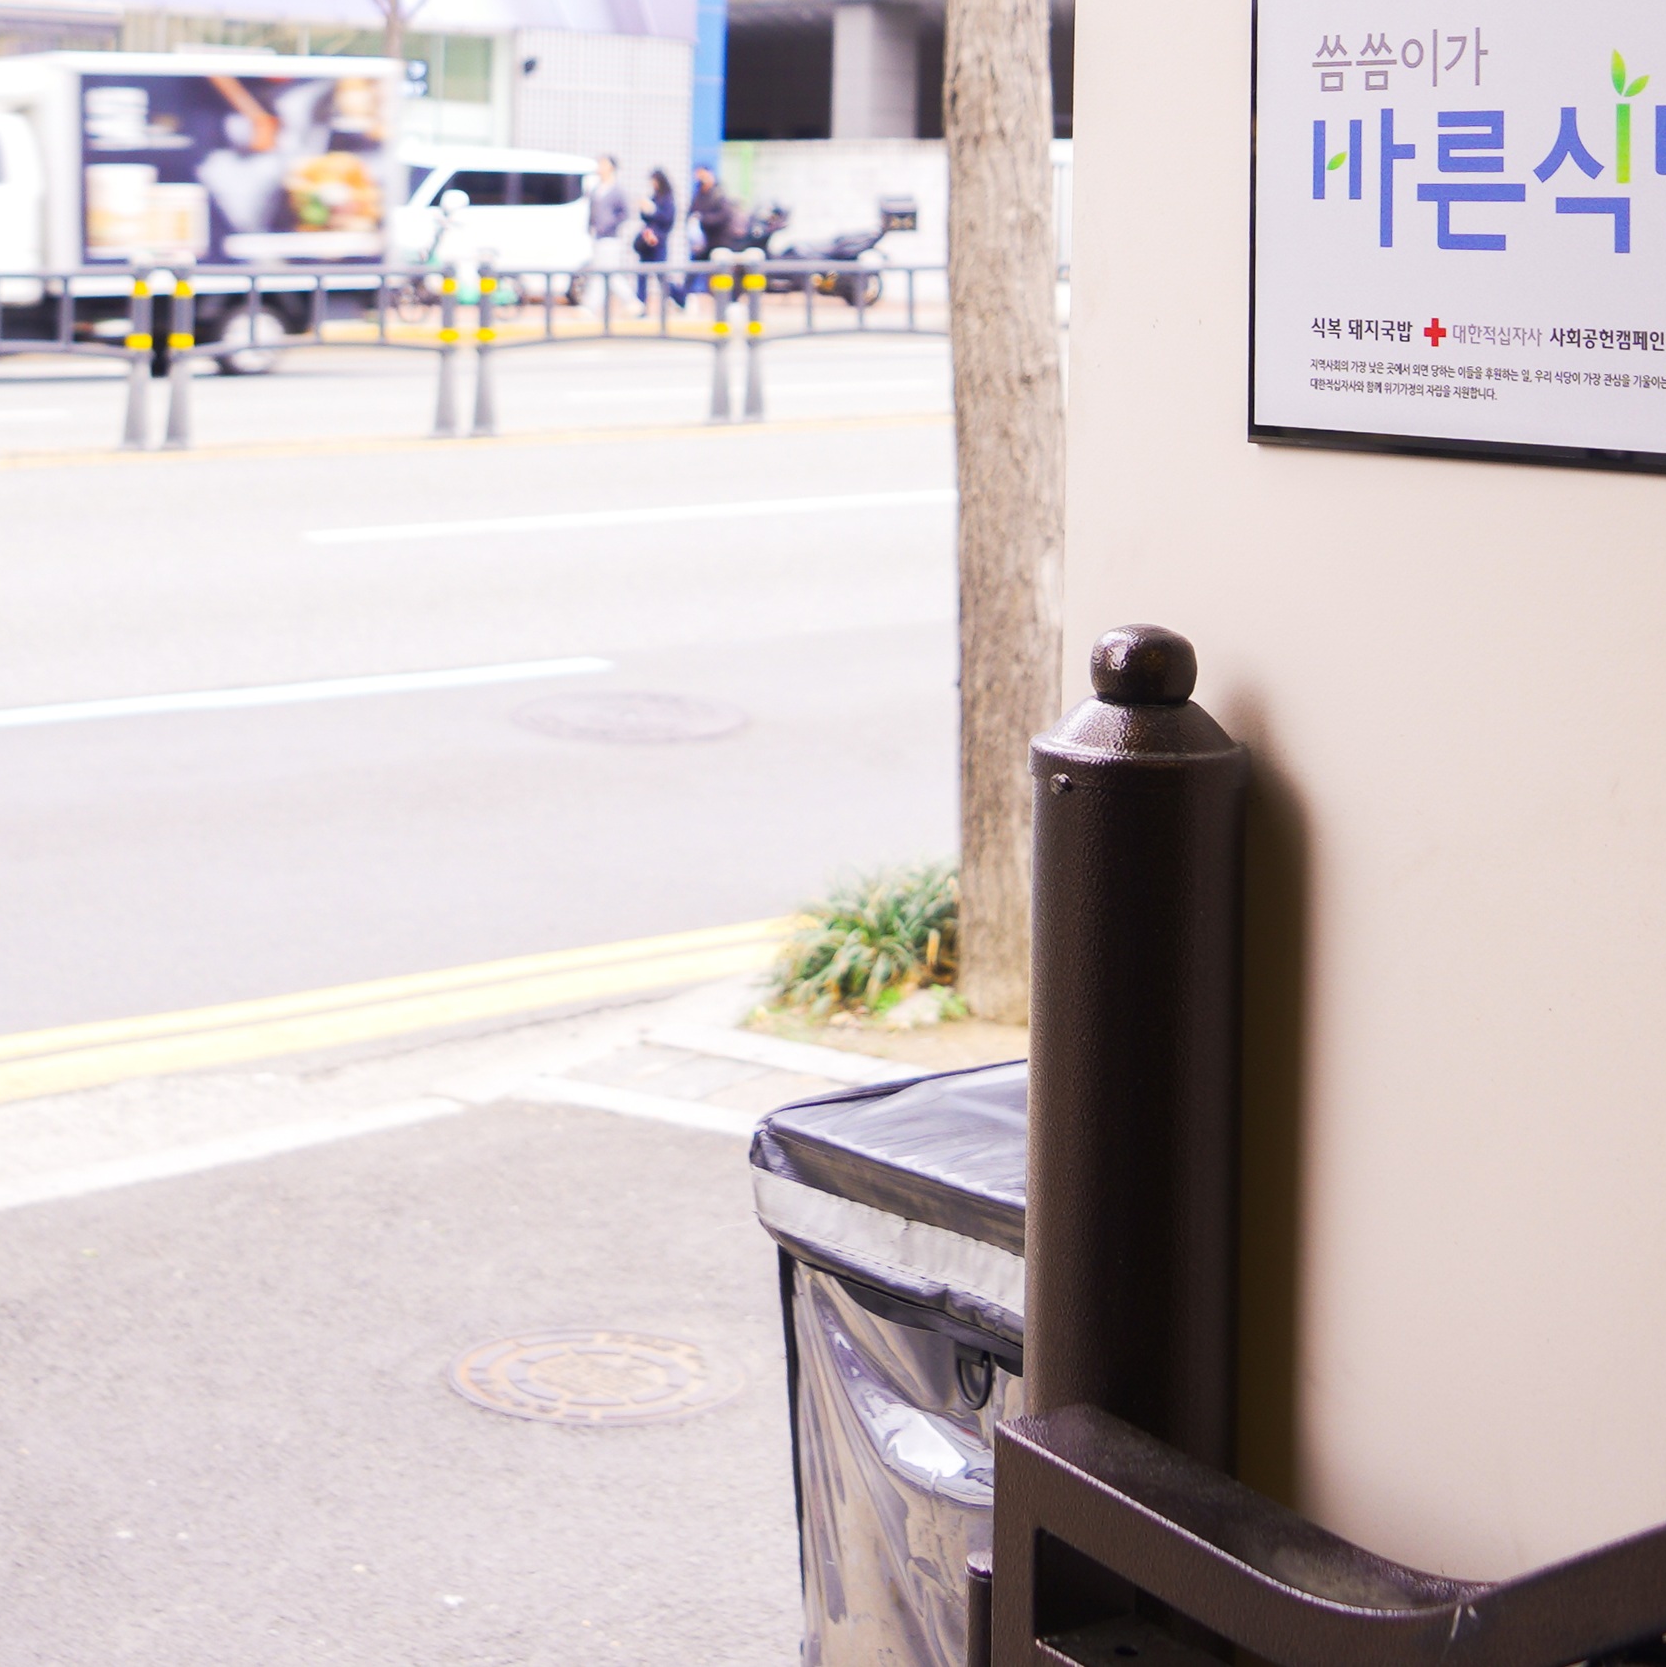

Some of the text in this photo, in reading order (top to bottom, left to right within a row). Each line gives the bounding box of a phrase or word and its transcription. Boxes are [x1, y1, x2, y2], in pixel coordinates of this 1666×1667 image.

[1312, 26, 1488, 93] 씀씀이가
[1310, 317, 1666, 352] 식복 돼지국밥 대한적십자사 사회공헌캠페인
[1309, 358, 1349, 373] 지역사회의
[1350, 360, 1367, 374] 가장
[1368, 361, 1384, 375] 낮은
[1386, 362, 1411, 376] 곳에서
[1431, 365, 1456, 379] 당하는
[1485, 367, 1519, 382] 후원하는
[1534, 369, 1552, 383] 우리
[1554, 371, 1581, 385] 식당이
[1583, 372, 1601, 386] 가장
[1603, 373, 1631, 388] 관심을
[1309, 377, 1365, 394] 대한적십자사와
[1384, 382, 1424, 397] 위기가정의
[1426, 384, 1451, 399] 자립을
[1453, 386, 1498, 401] 지원합니다.
